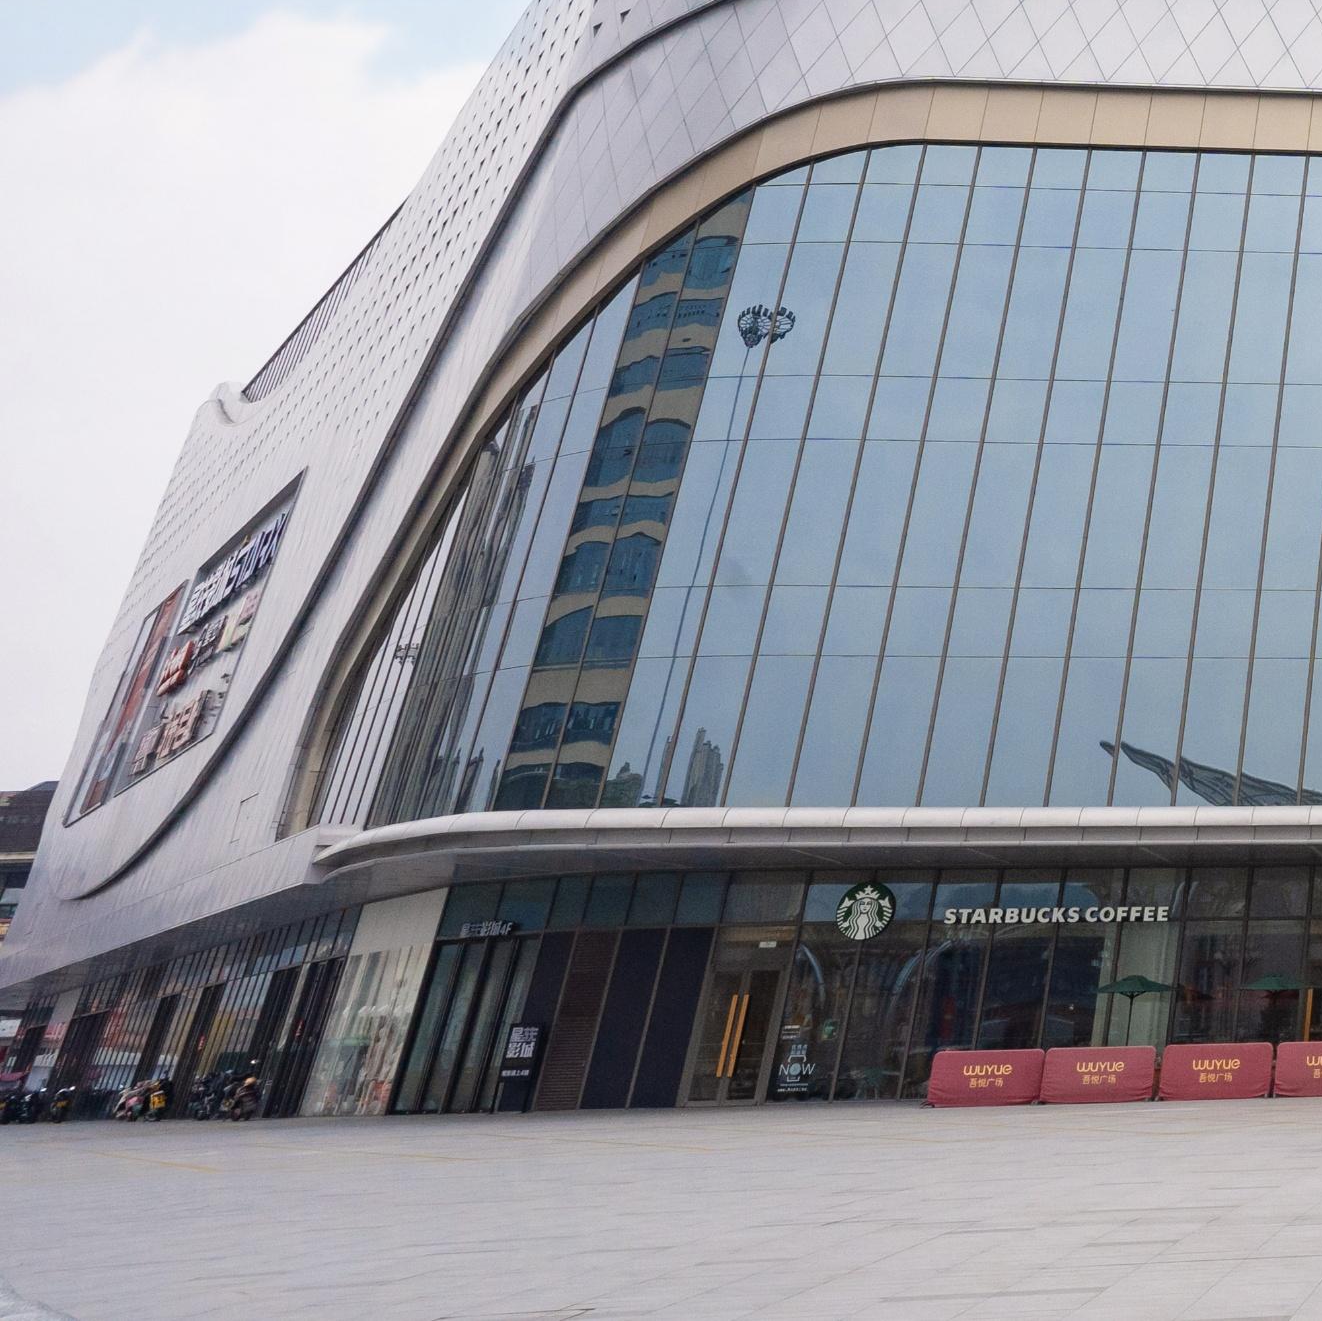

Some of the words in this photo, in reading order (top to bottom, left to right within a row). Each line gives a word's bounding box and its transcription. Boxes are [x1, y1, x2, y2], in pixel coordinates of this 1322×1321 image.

[943, 906, 1080, 925] STARBUCKS
[1085, 906, 1169, 923] COFFEE
[1082, 1075, 1117, 1085] 吾悦广场
[1199, 1072, 1233, 1083] 吾悦广场
[969, 1078, 1004, 1088] 吾悦广场
